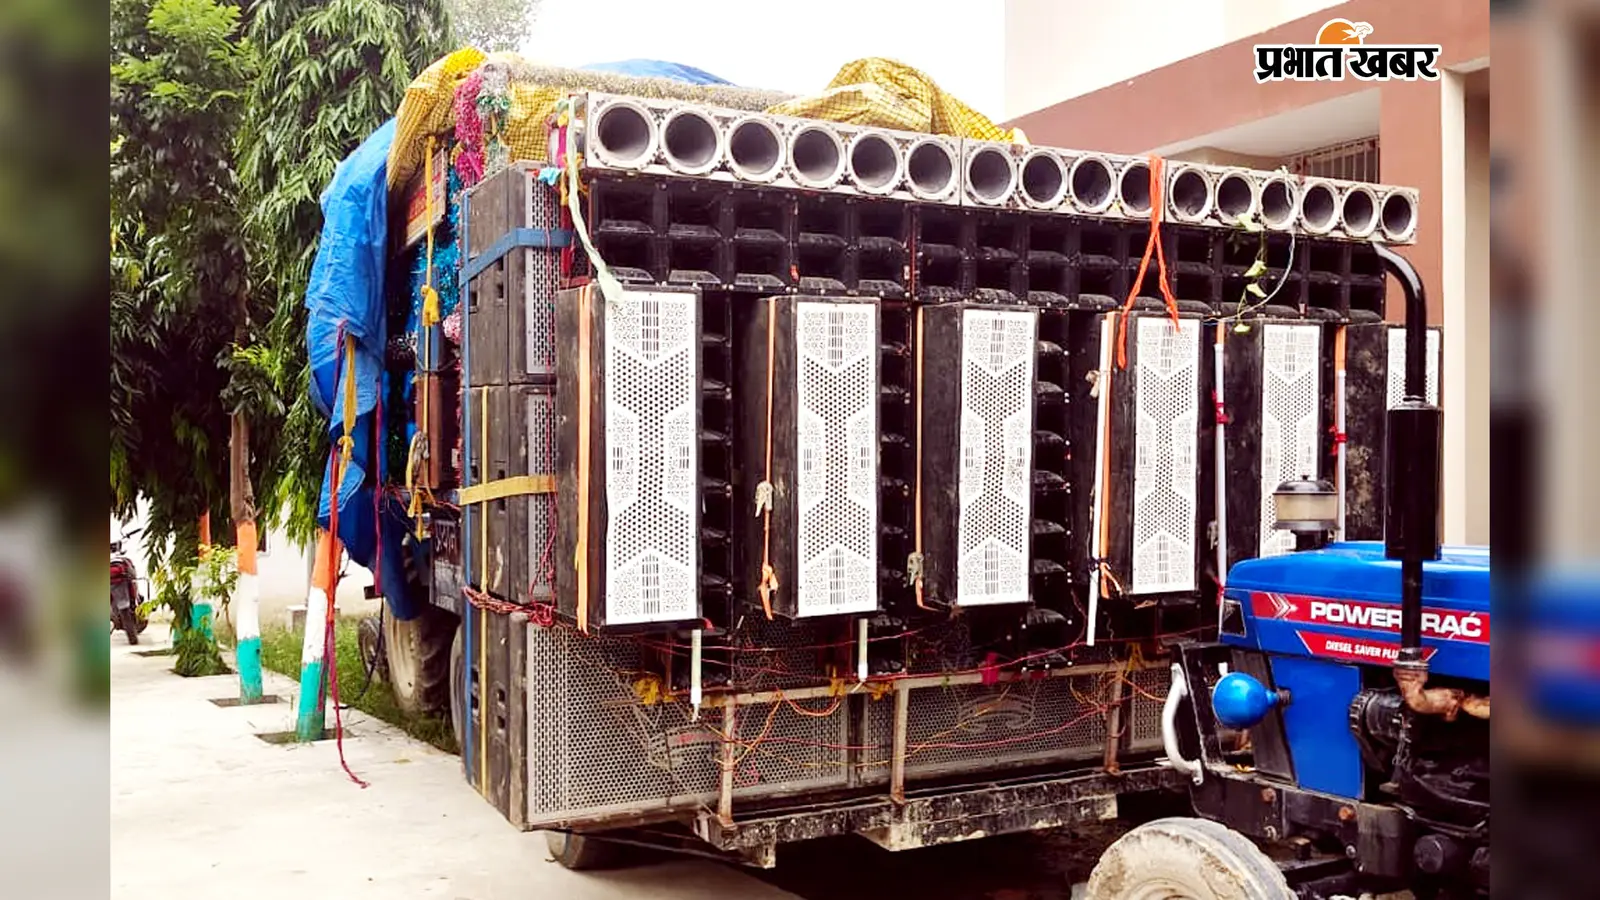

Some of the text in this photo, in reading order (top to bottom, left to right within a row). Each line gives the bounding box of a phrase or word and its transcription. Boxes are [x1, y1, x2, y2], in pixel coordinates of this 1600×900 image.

[1311, 601, 1482, 638] POWERRAC
[1325, 640, 1400, 660] DIESEL SAVER PLU
